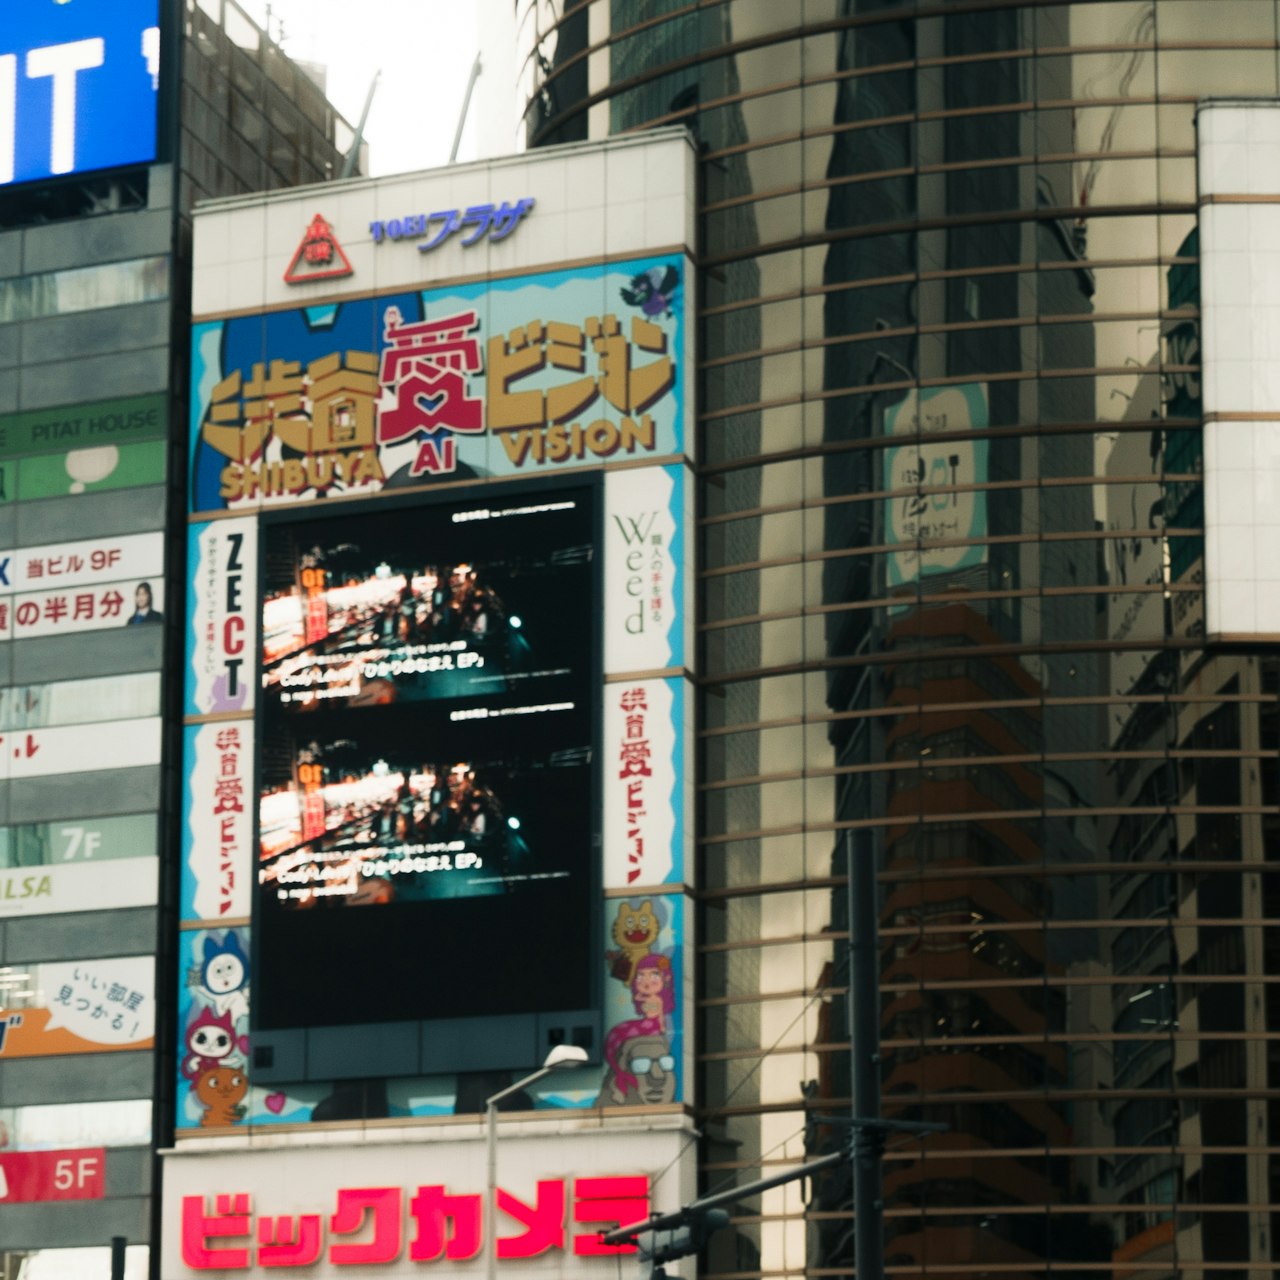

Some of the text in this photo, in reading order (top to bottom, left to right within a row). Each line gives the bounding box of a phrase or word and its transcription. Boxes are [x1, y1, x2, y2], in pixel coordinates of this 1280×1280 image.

[31, 419, 87, 441] PITAT
[90, 408, 159, 434] HOUSE
[220, 415, 656, 500] SHIBUYA AI VISION
[26, 554, 84, 580] 当ビル
[90, 549, 122, 572] 9F
[612, 511, 659, 635] Weed
[223, 532, 246, 697] ZECT
[60, 826, 102, 861] 7F
[73, 967, 145, 1013] いい部屋
[54, 1158, 99, 1191] 5F
[181, 1176, 650, 1271] ビックカメラ
